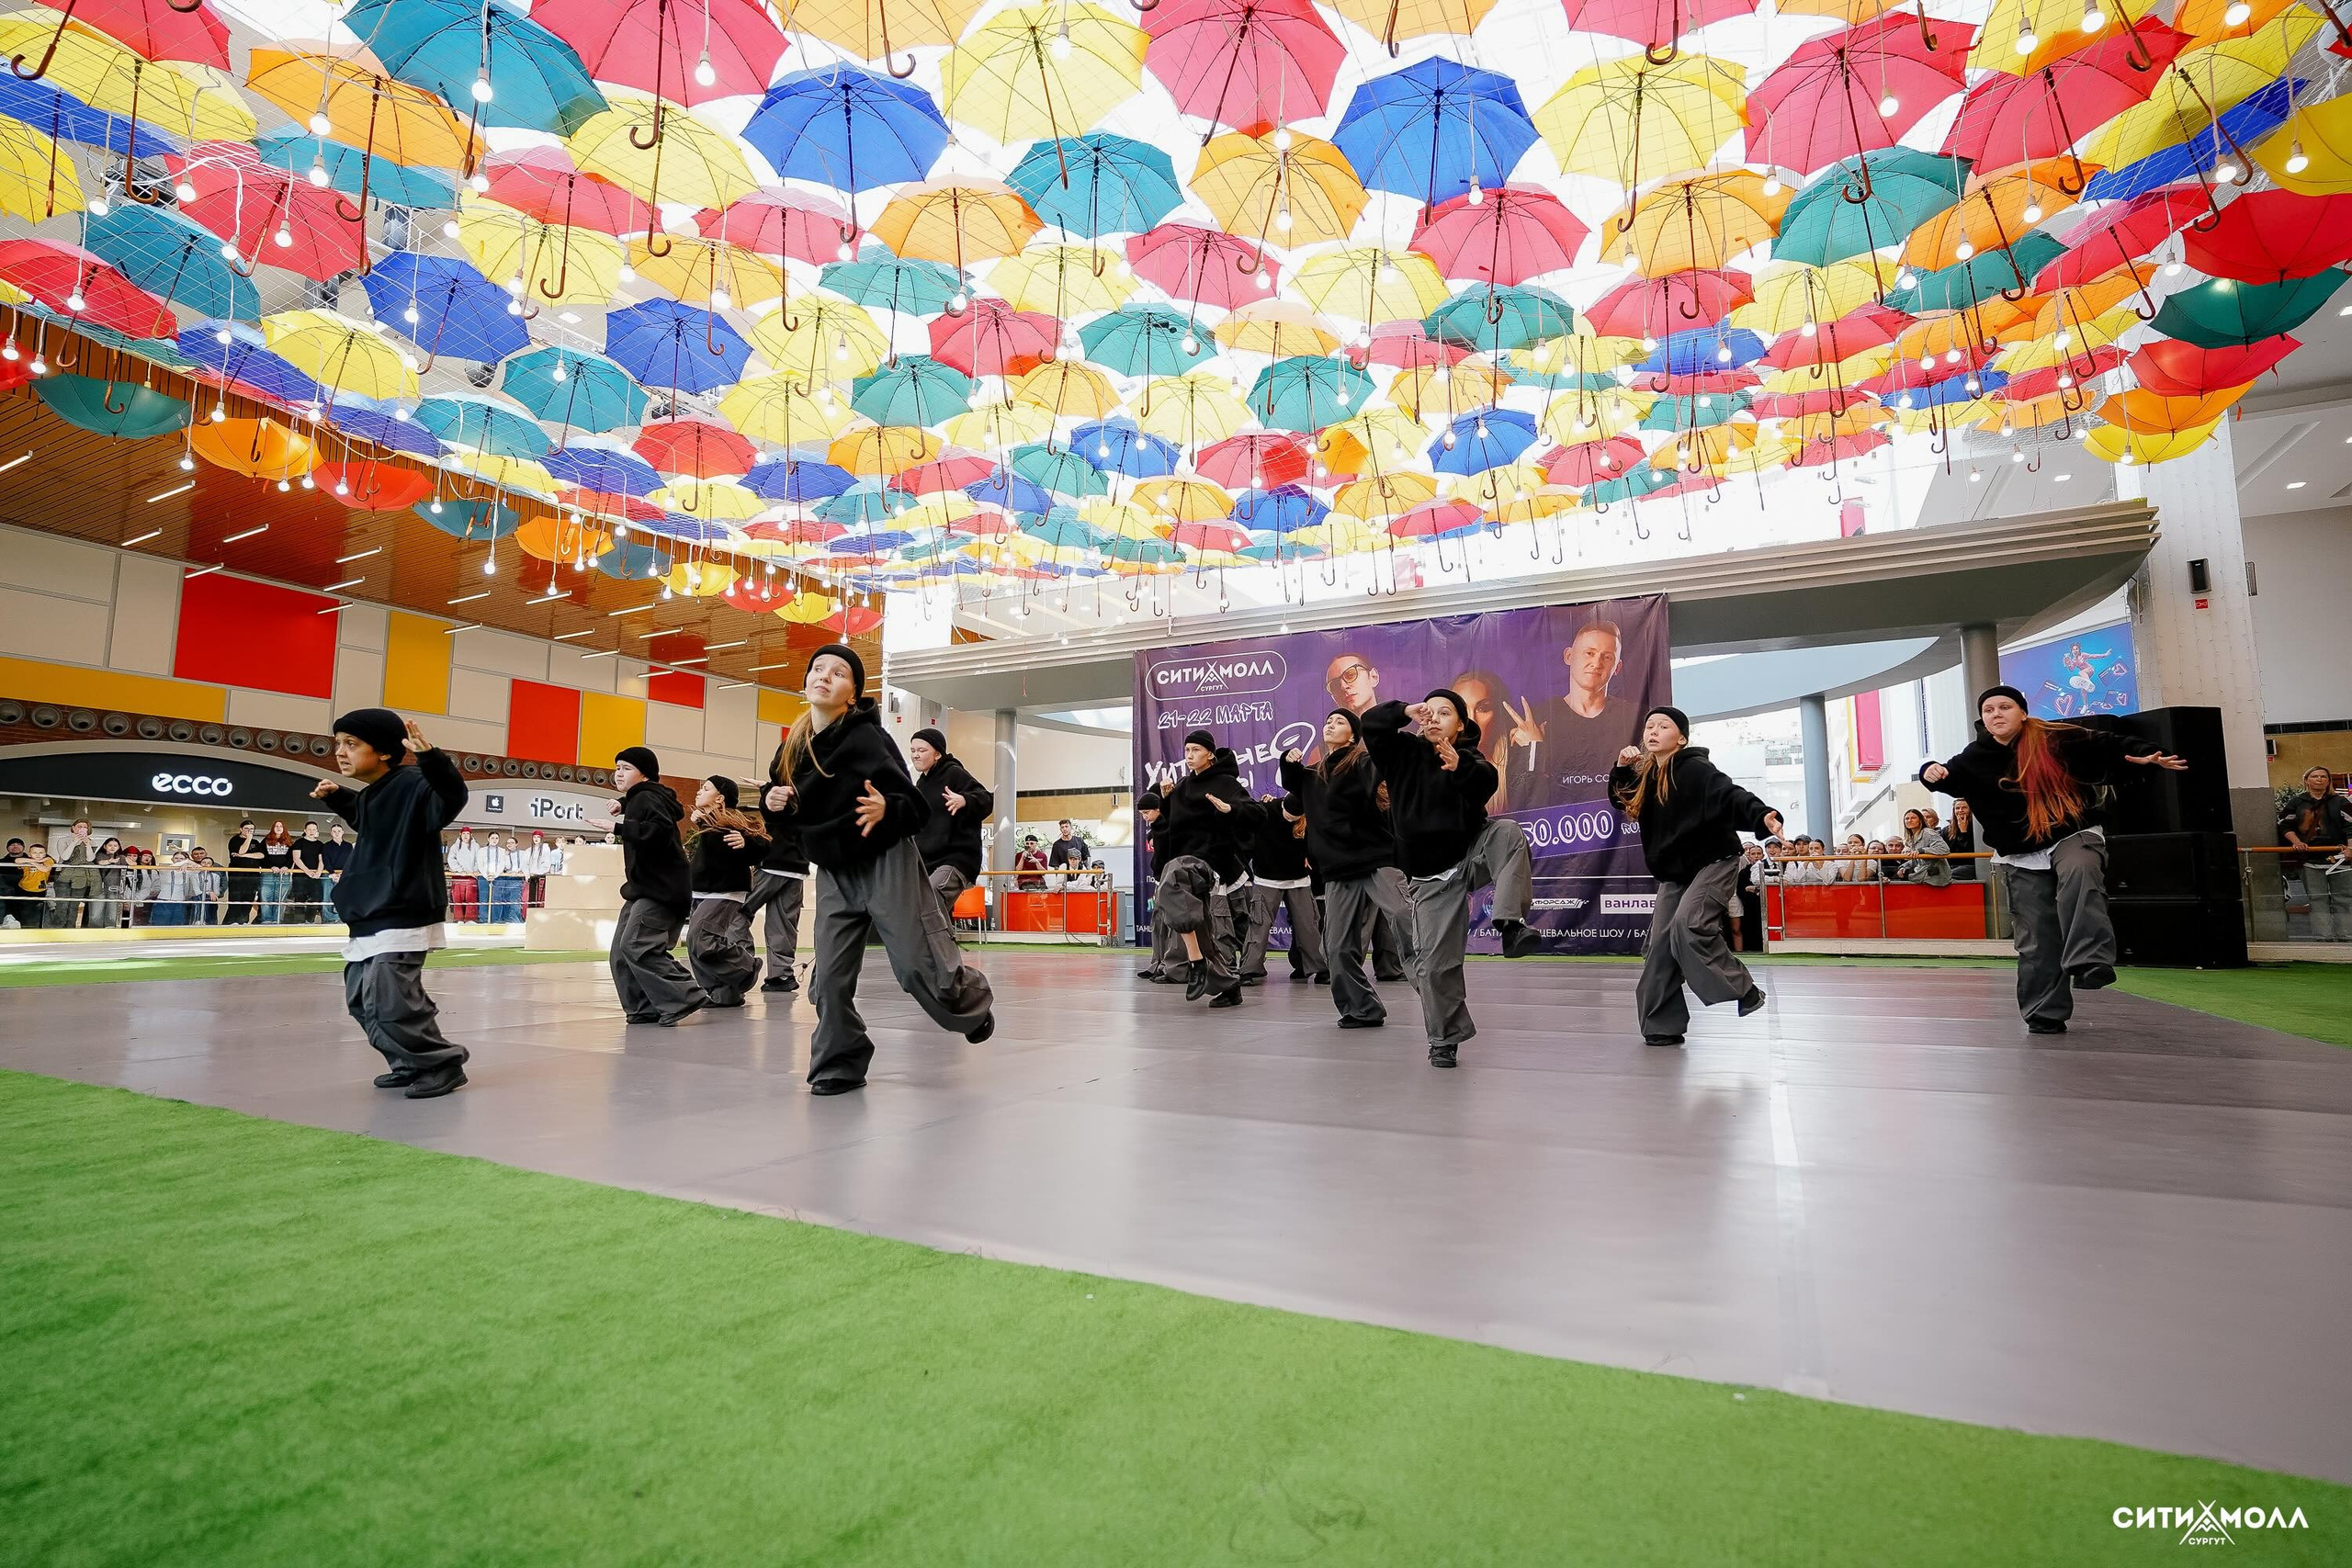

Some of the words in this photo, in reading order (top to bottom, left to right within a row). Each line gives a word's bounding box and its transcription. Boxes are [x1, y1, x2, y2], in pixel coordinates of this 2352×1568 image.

[1157, 666, 1204, 684] СИТИ
[1219, 660, 1274, 678] МОЛЛ
[1158, 708, 1213, 729] 21-22
[1216, 701, 1273, 725] МАРТА
[152, 773, 232, 796] ecco
[1562, 775, 1593, 784] ИГОРЬ
[530, 797, 583, 819] iPort
[1621, 822, 1640, 834] RU
[1600, 929, 1624, 937] ШОУ
